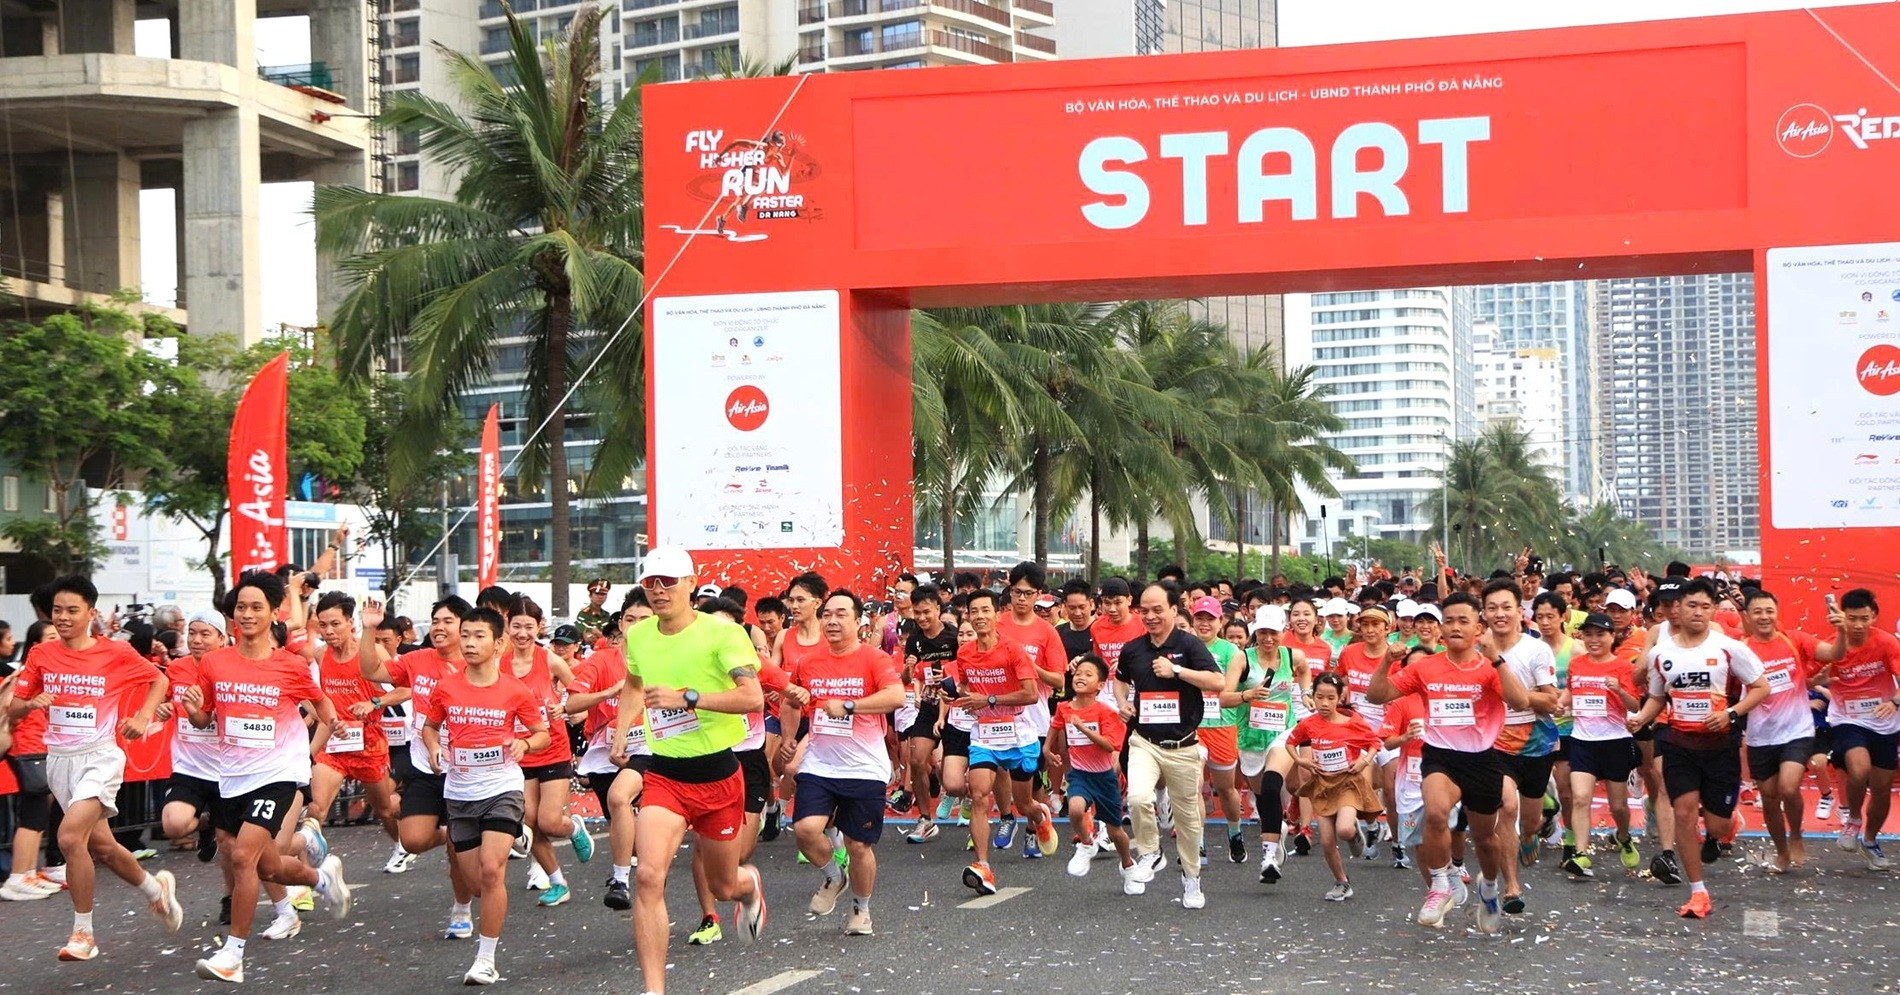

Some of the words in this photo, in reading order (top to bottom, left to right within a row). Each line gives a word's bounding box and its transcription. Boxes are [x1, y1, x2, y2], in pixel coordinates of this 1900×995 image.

[1065, 101, 1084, 115] BỘ
[1088, 98, 1114, 112] VĂN
[1118, 96, 1151, 111] HÓA,
[1183, 94, 1219, 107] THAO
[1222, 92, 1241, 104] VÀ
[1245, 91, 1264, 103] DU
[1268, 90, 1298, 104] LỊCH
[1310, 87, 1350, 100] UBND
[1353, 83, 1401, 97] THÀNH
[1404, 79, 1435, 93] PHỐ
[1438, 79, 1458, 91] ĐÀ
[685, 129, 724, 153] FLY
[700, 150, 766, 169] HIGHER
[1077, 115, 1491, 230] START
[722, 166, 791, 197] RUN
[753, 195, 804, 210] FASTER
[759, 211, 771, 219] DA
[773, 210, 797, 219] NANG
[43, 673, 57, 684] FLY
[60, 674, 106, 687] HIGHER
[826, 677, 864, 687] HIGHER
[43, 685, 61, 694] RUN
[64, 686, 105, 697] FASTER
[215, 681, 232, 693] FLY
[234, 683, 280, 697] HIGHER
[216, 693, 236, 703] RUN
[238, 694, 279, 707] FASTER
[606, 698, 619, 707] RU
[1444, 702, 1471, 710] 50284
[65, 711, 94, 720] 54846
[465, 707, 506, 719] HIGHER
[243, 722, 273, 732] 54830
[469, 717, 505, 726] FASTER
[992, 725, 1012, 733] 52502
[473, 750, 499, 759] 53431
[1322, 751, 1343, 759] 50917
[252, 799, 276, 820] 73
